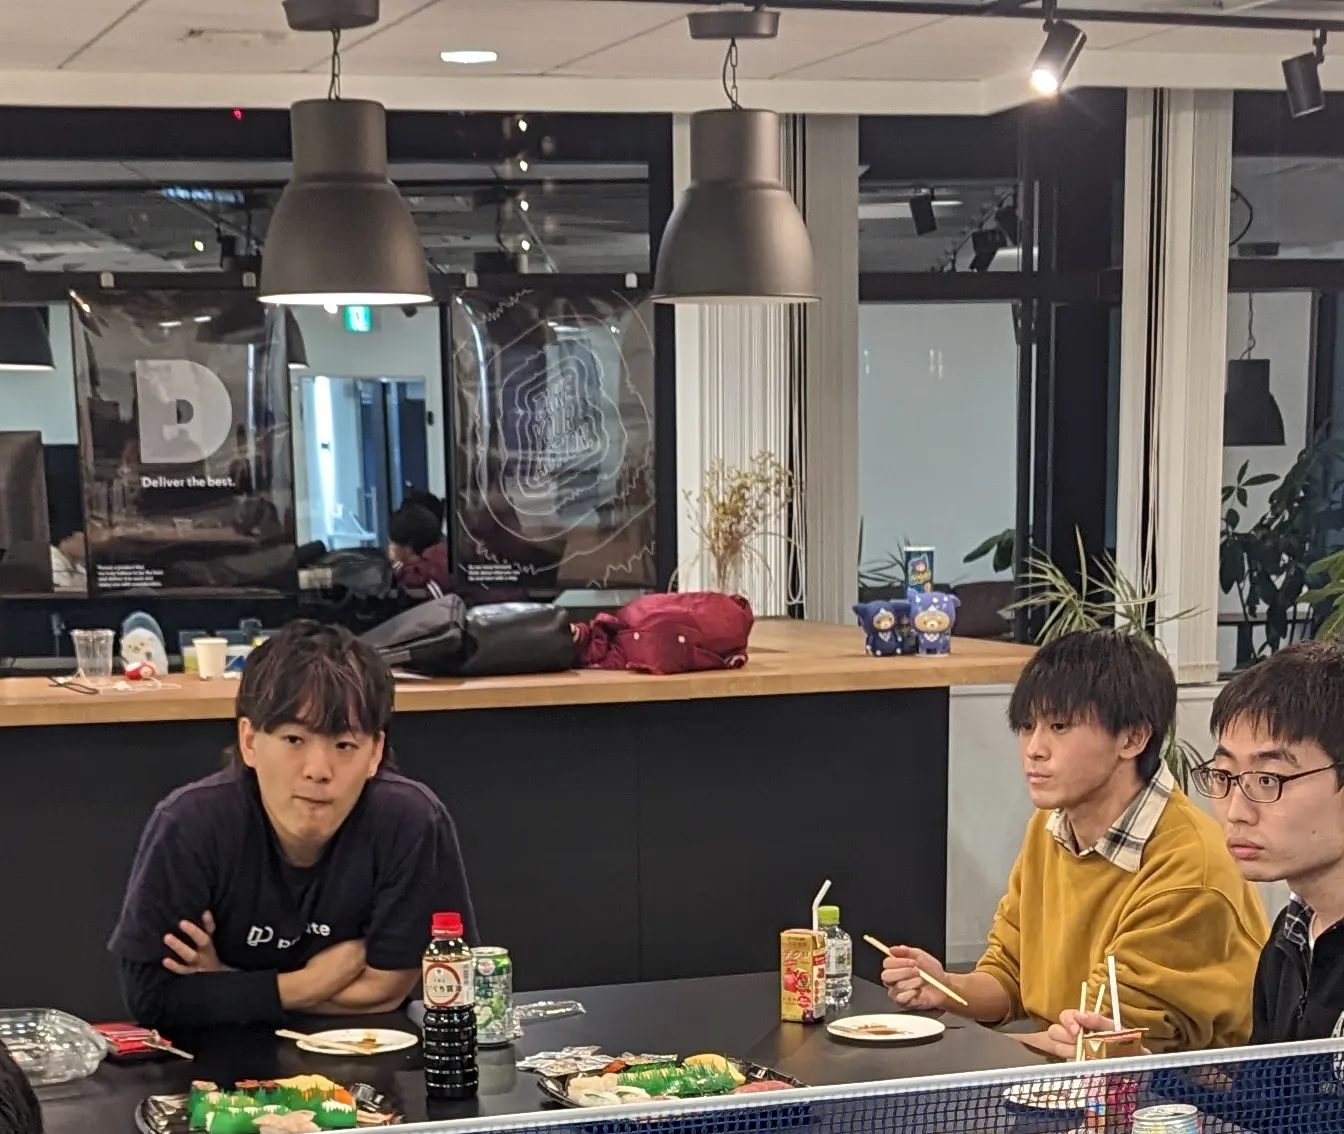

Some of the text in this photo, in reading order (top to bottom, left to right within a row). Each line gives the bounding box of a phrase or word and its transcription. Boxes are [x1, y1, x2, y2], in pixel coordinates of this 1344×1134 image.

[135, 359, 233, 464] D
[142, 476, 236, 488] Deliver the best.
